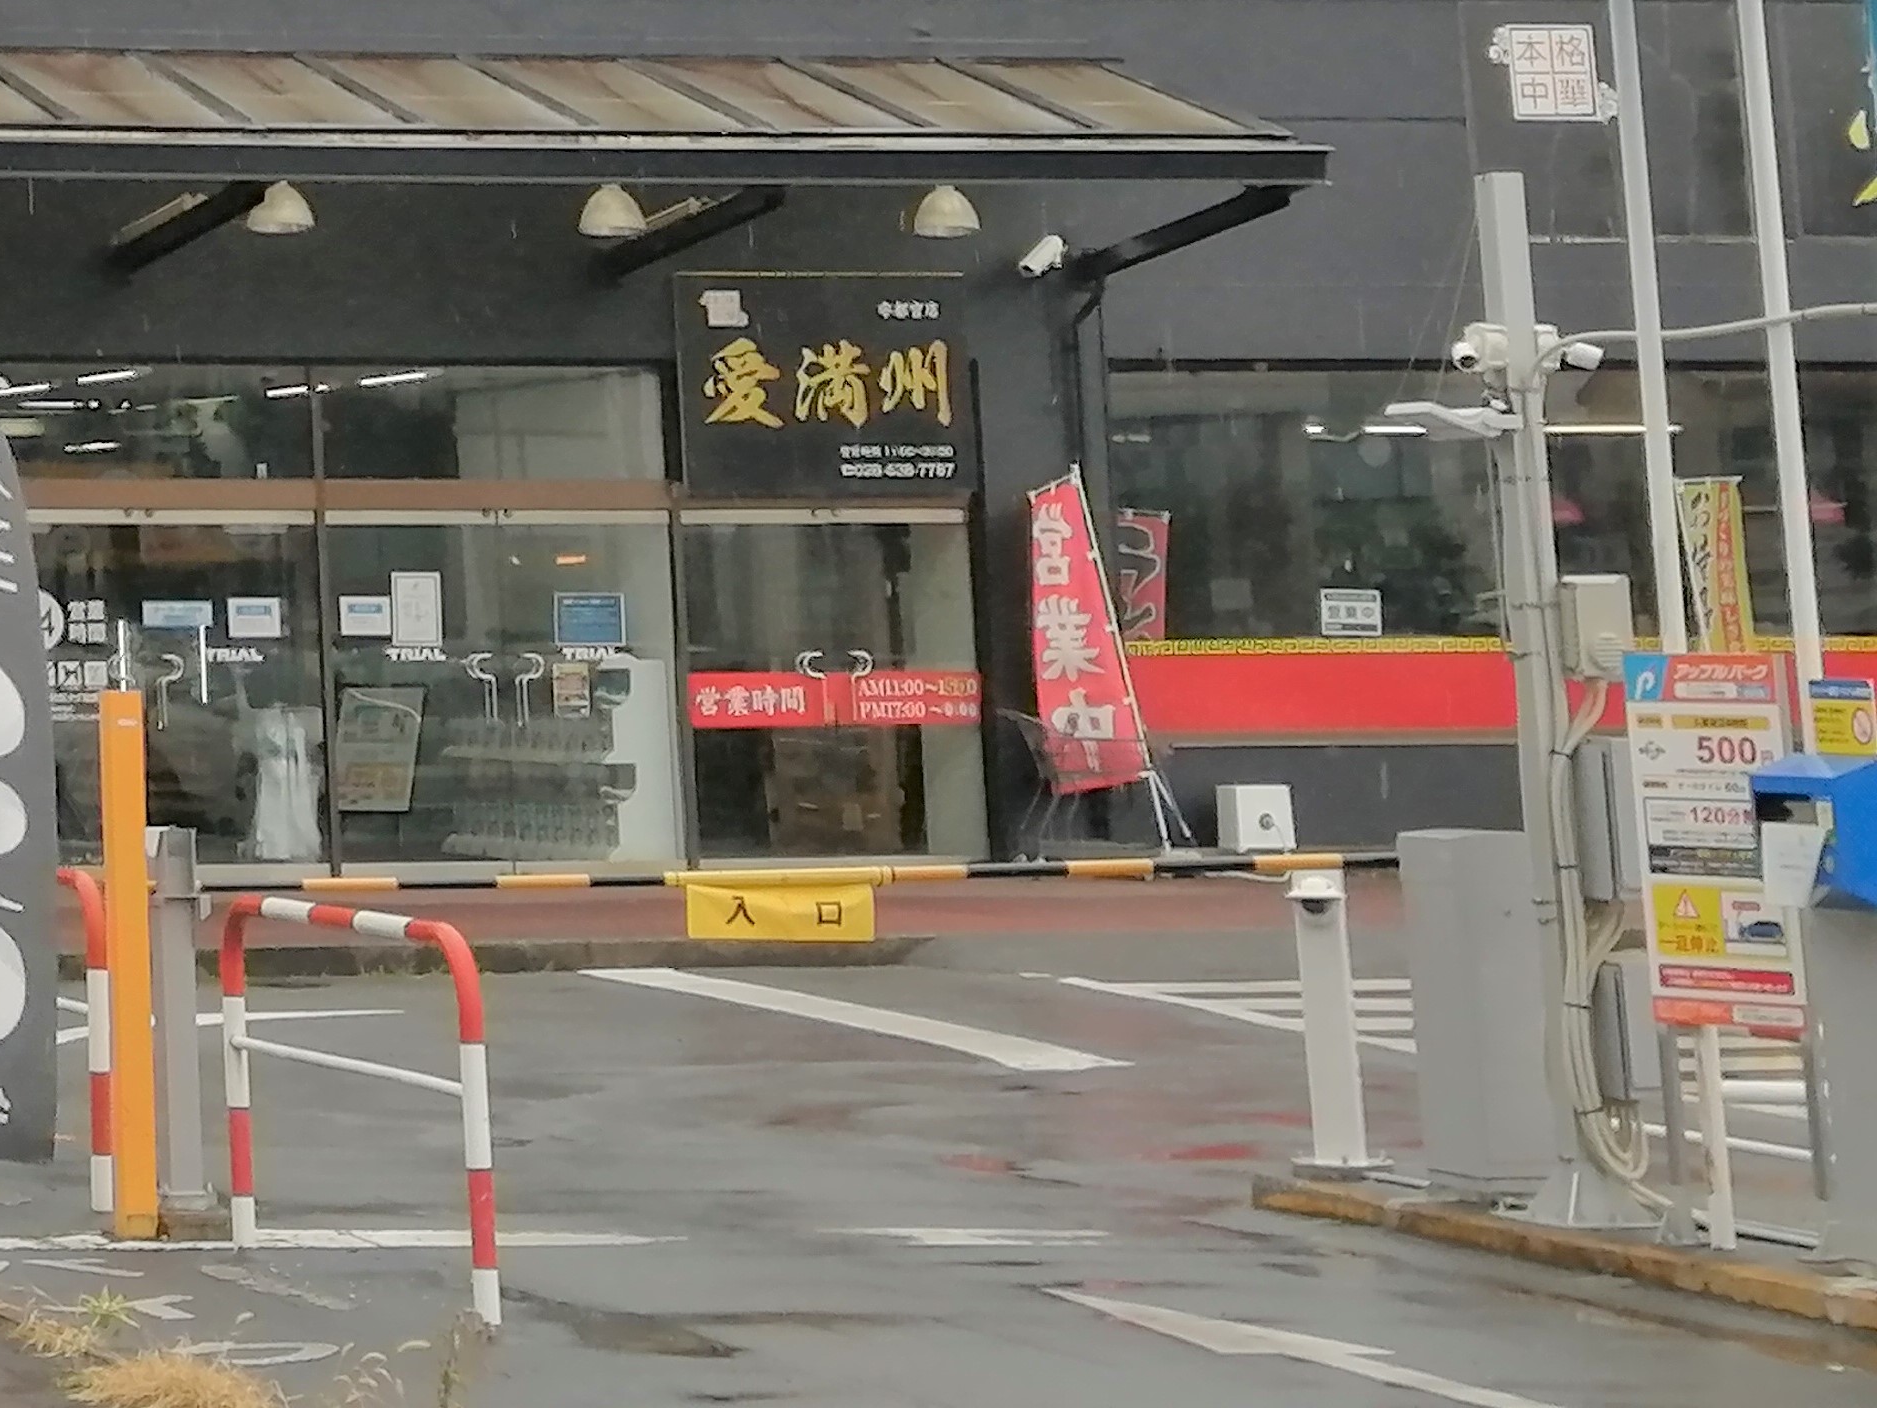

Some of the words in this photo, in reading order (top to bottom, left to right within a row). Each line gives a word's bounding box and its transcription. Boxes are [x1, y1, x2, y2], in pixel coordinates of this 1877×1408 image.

[1516, 34, 1585, 67] 本格
[1520, 77, 1588, 109] 中華
[702, 337, 953, 429] 愛満州
[1031, 502, 1115, 776] 営業中
[1673, 664, 1769, 680] アップルパーク
[696, 685, 806, 716] 営業時間
[726, 896, 842, 926] 入口
